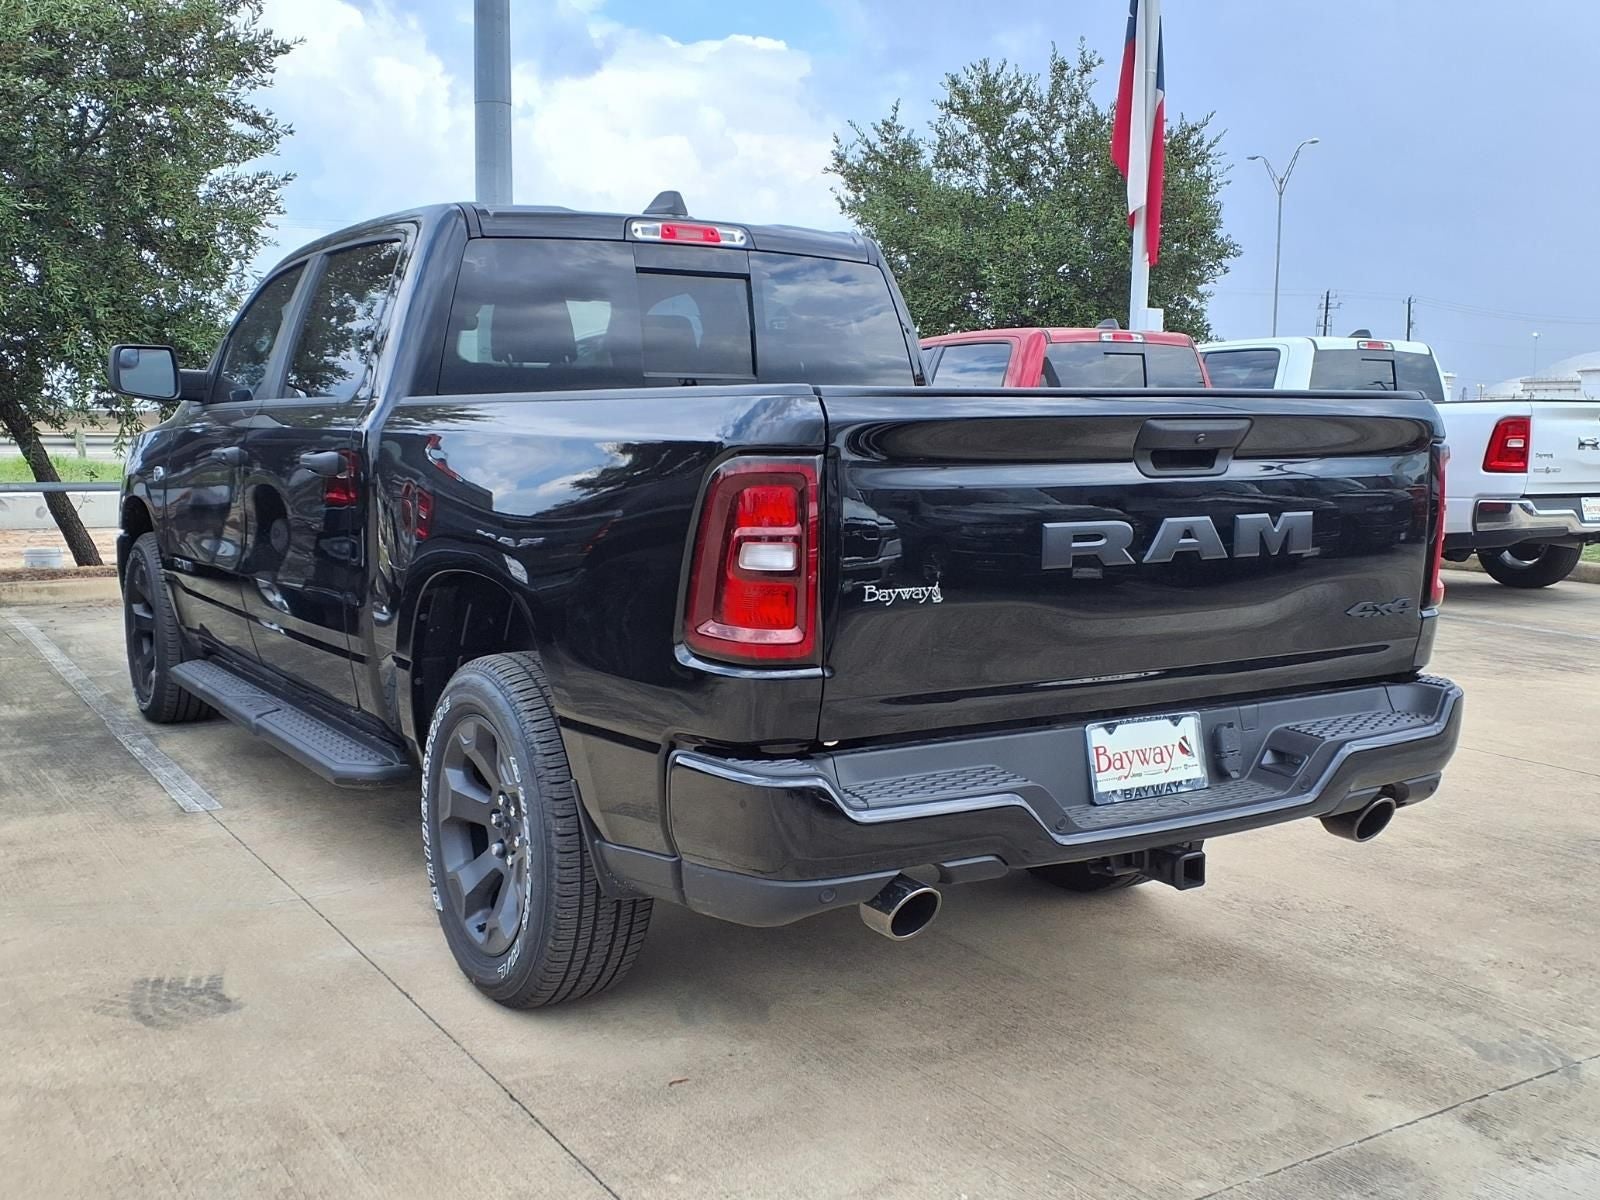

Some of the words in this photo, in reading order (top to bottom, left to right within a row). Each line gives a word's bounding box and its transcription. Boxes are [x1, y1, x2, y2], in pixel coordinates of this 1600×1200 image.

[1041, 510, 1314, 570] RAM
[863, 585, 934, 606] Bayway
[1093, 744, 1175, 780] Bayway
[1123, 780, 1183, 800] BAYWAY
